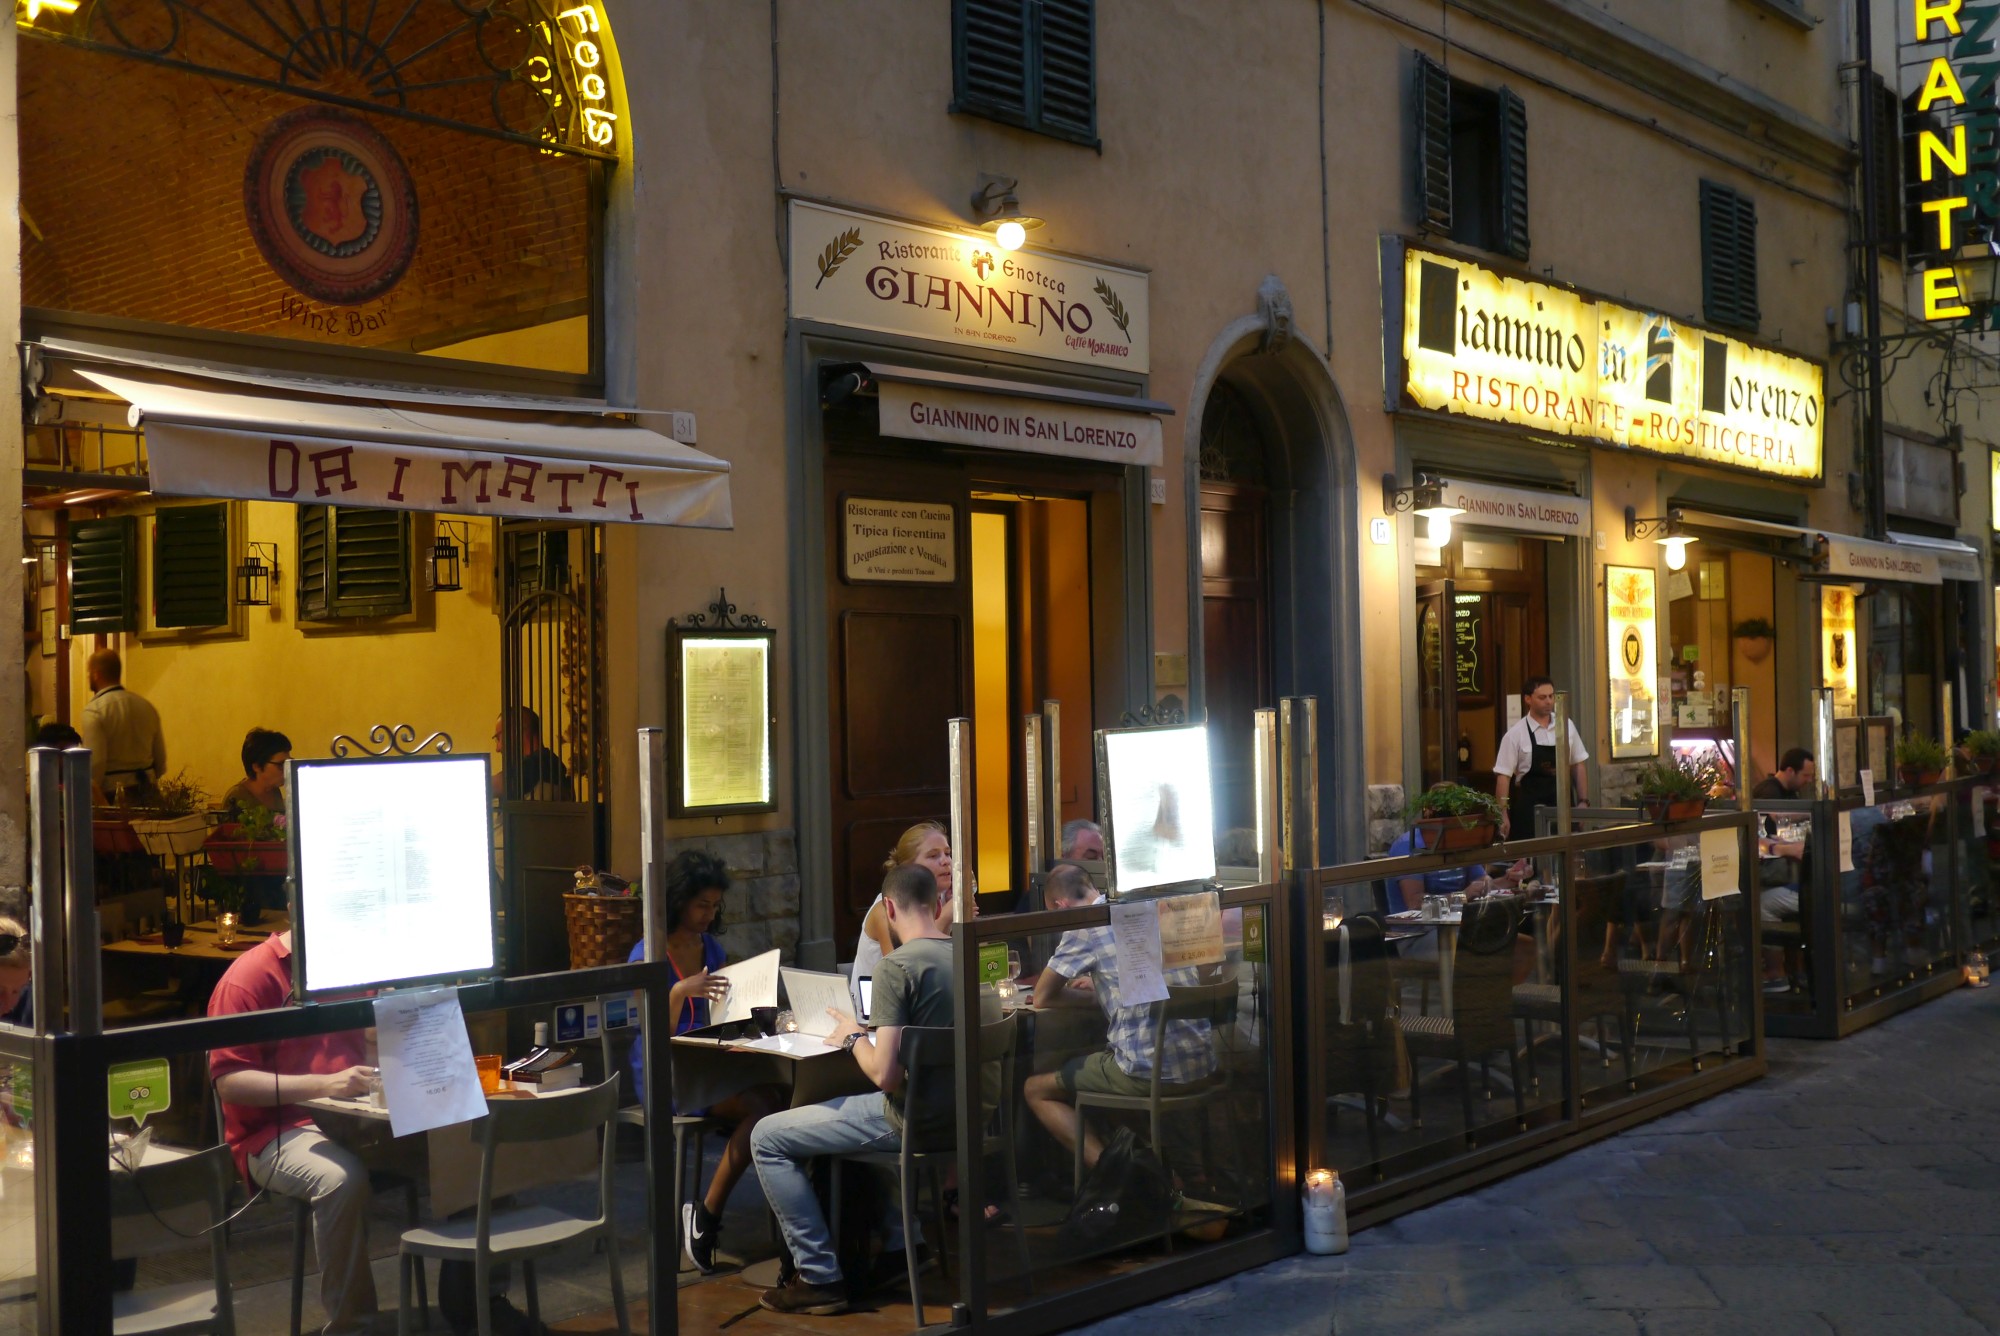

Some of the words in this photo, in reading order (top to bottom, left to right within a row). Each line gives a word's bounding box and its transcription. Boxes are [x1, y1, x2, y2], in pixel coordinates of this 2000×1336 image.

[877, 240, 962, 263] Ristorante
[1002, 258, 1066, 295] Enoteca
[280, 291, 340, 335] Wine
[345, 308, 387, 336] Bar
[865, 265, 1093, 337] GIANNINO
[1065, 334, 1087, 350] Caffè
[676, 416, 693, 437] 31
[910, 401, 999, 434] GIANNINO
[1003, 417, 1020, 436] IN
[1024, 416, 1059, 441] SAN
[1063, 421, 1137, 449] LORENZO
[268, 439, 358, 500] DA
[386, 456, 412, 502] I
[440, 455, 645, 521] MATTI
[847, 503, 898, 518] Ristorante
[901, 509, 917, 519] con
[920, 508, 951, 521] Cucina
[1506, 503, 1516, 518] IN
[1518, 502, 1537, 520] SAN
[1538, 504, 1579, 526] LORENZO
[852, 523, 889, 538] Tipica
[892, 526, 946, 540] fiorentina
[853, 542, 907, 565] Degustazione
[909, 546, 914, 555] e
[916, 545, 947, 568] Vendita
